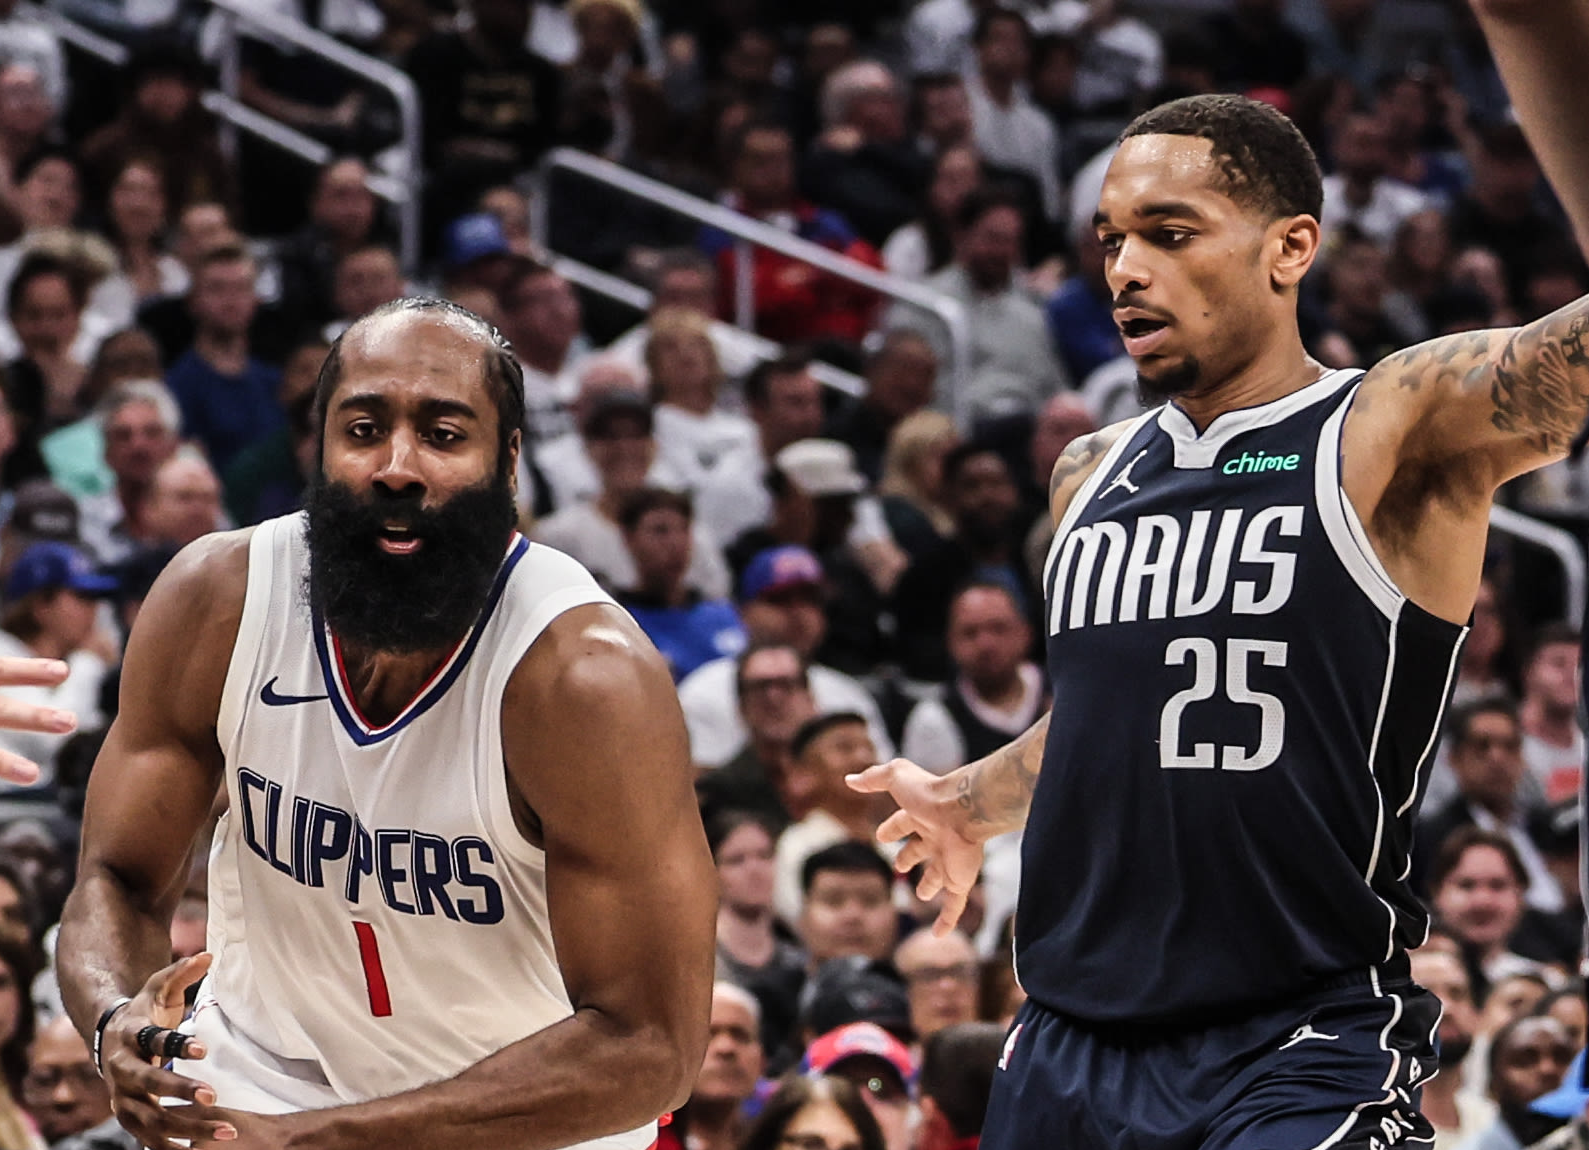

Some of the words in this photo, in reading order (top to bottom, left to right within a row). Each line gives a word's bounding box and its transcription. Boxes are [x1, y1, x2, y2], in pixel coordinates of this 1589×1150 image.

[1222, 450, 1300, 475] chime
[1049, 505, 1305, 637] MAVS
[1159, 637, 1288, 771] 25
[237, 766, 505, 925] CLIPPERS
[352, 920, 393, 1017] 1
